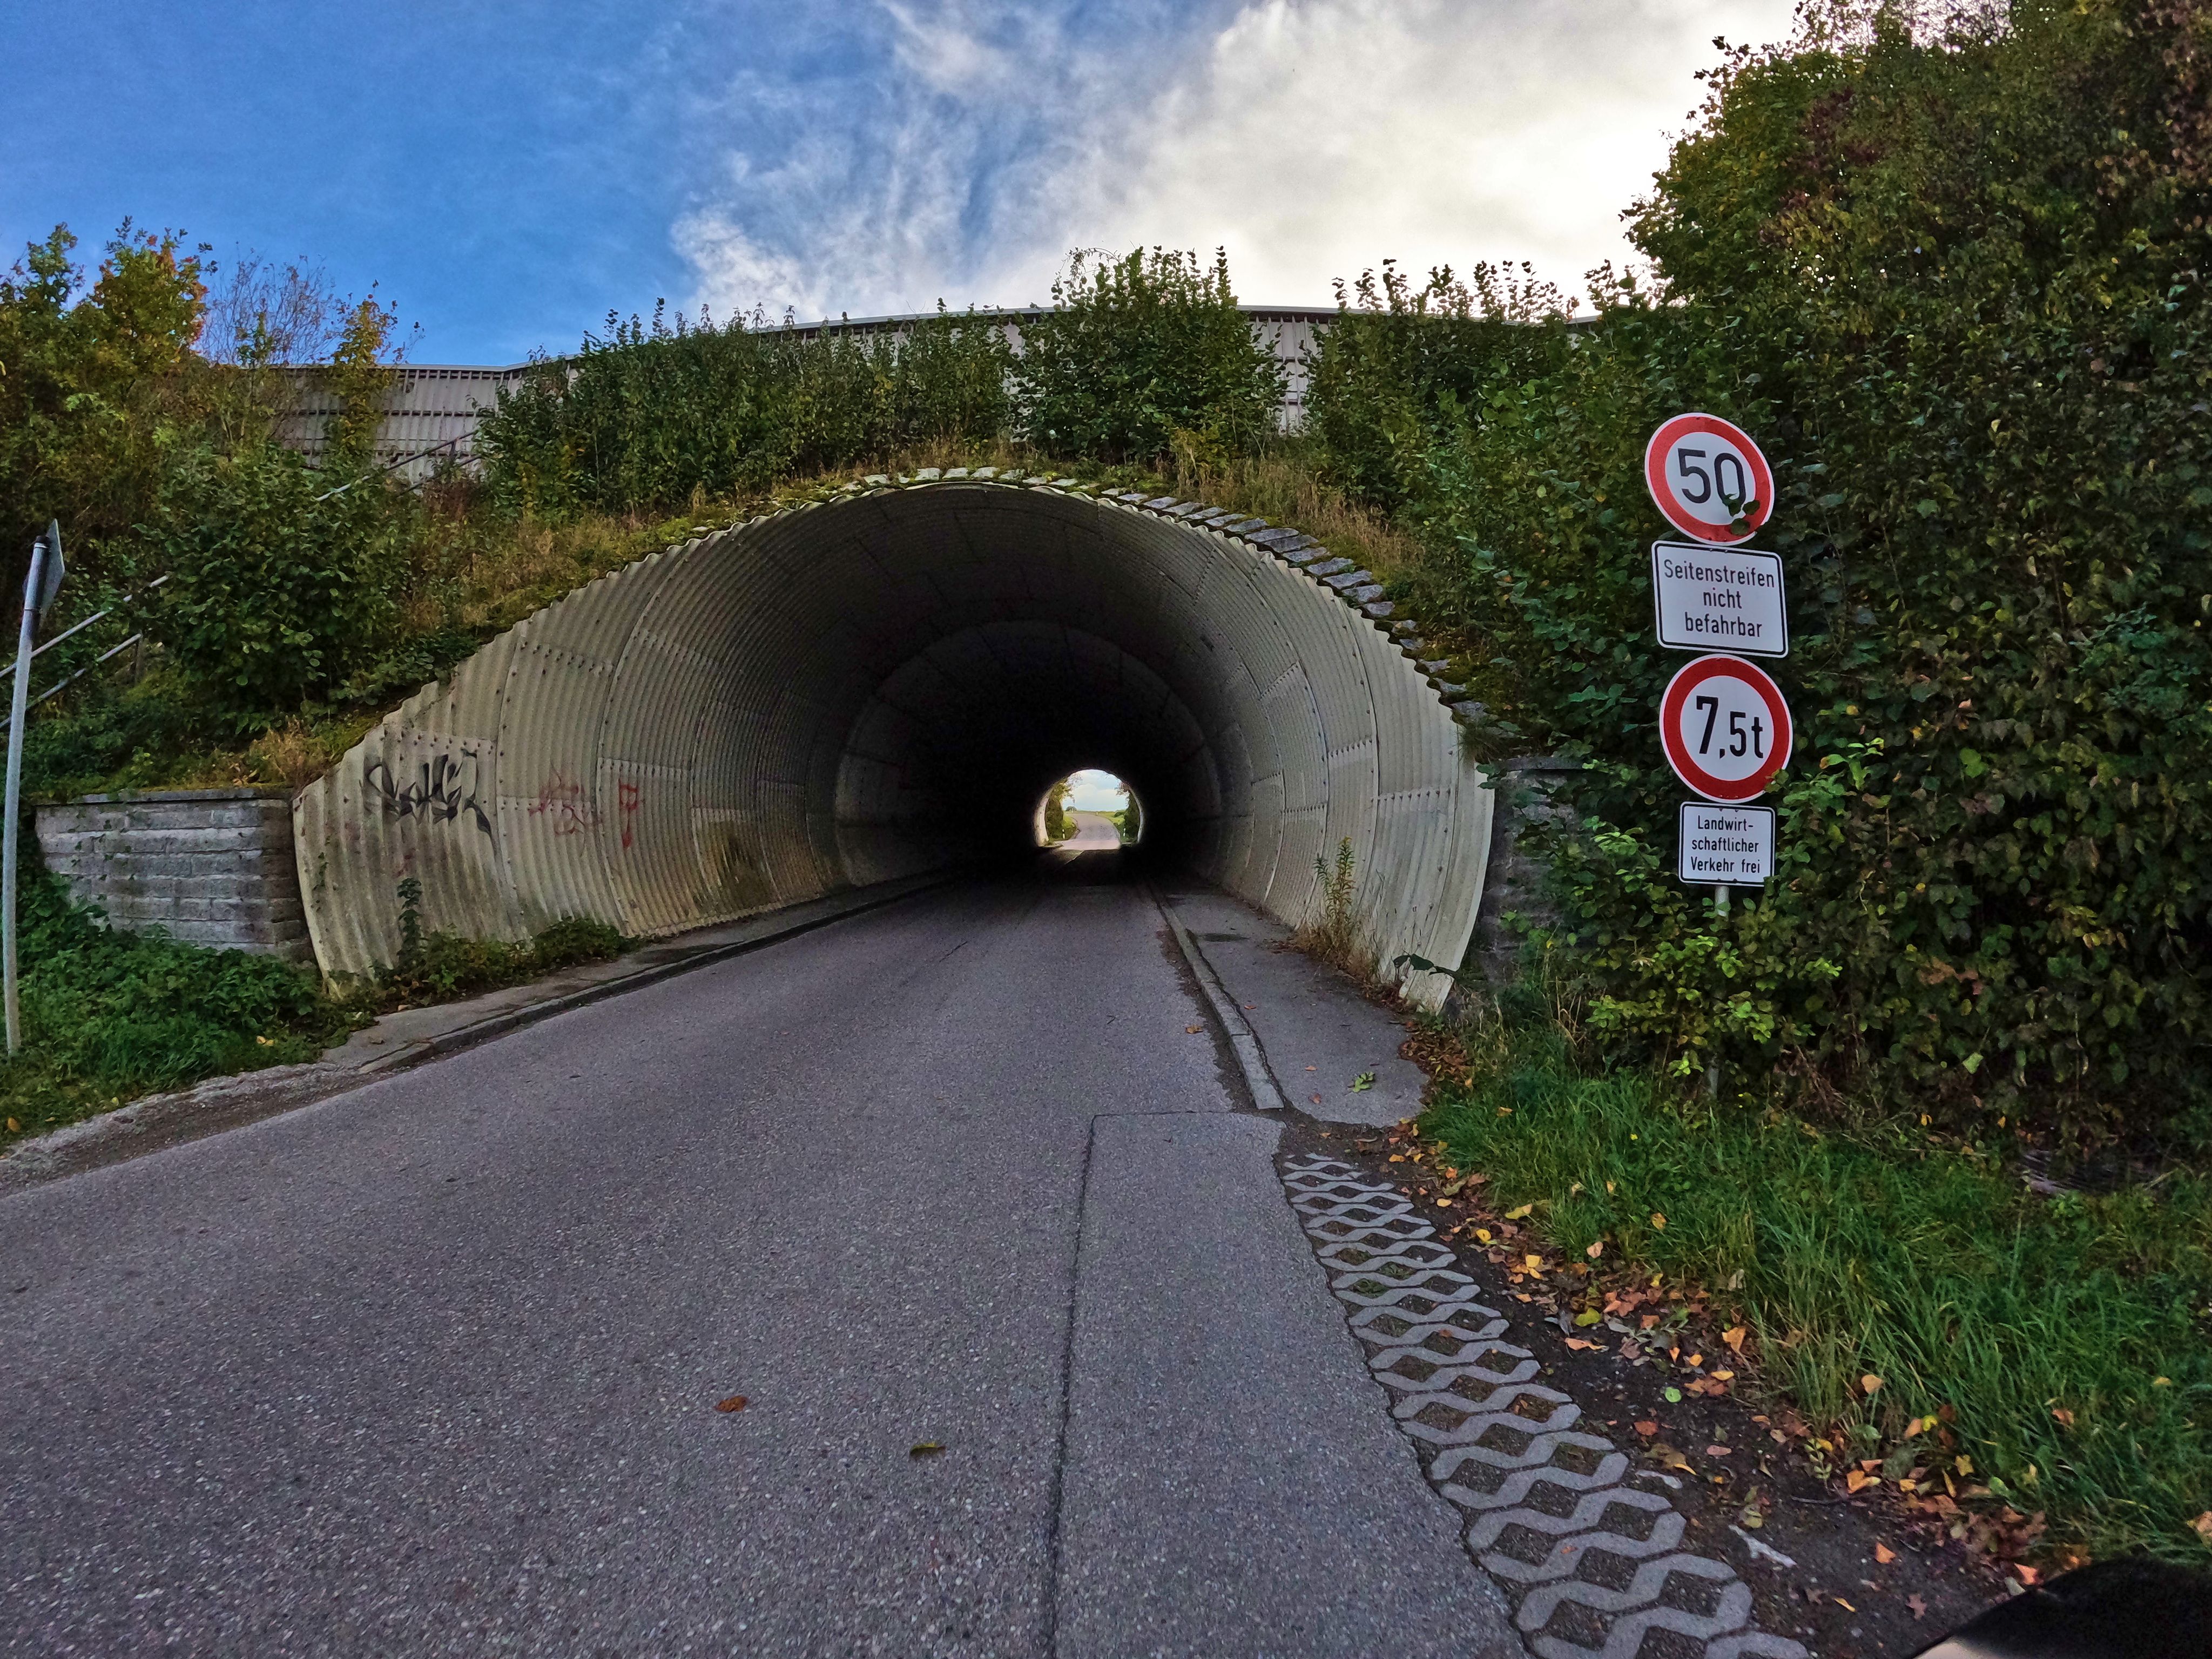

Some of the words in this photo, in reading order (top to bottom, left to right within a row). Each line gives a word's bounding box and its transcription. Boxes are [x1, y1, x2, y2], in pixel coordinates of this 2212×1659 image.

[1677, 448, 1746, 509] 50
[1664, 559, 1775, 588] Seitenstreifen
[1703, 587, 1742, 609] nicht
[1684, 611, 1763, 637] befahrbar
[1696, 695, 1763, 759] 7,5t
[1697, 815, 1754, 831] Landwirt-
[1691, 836, 1759, 853] schaftlicher
[1691, 856, 1735, 872] Verkehr
[1741, 859, 1761, 873] frei
